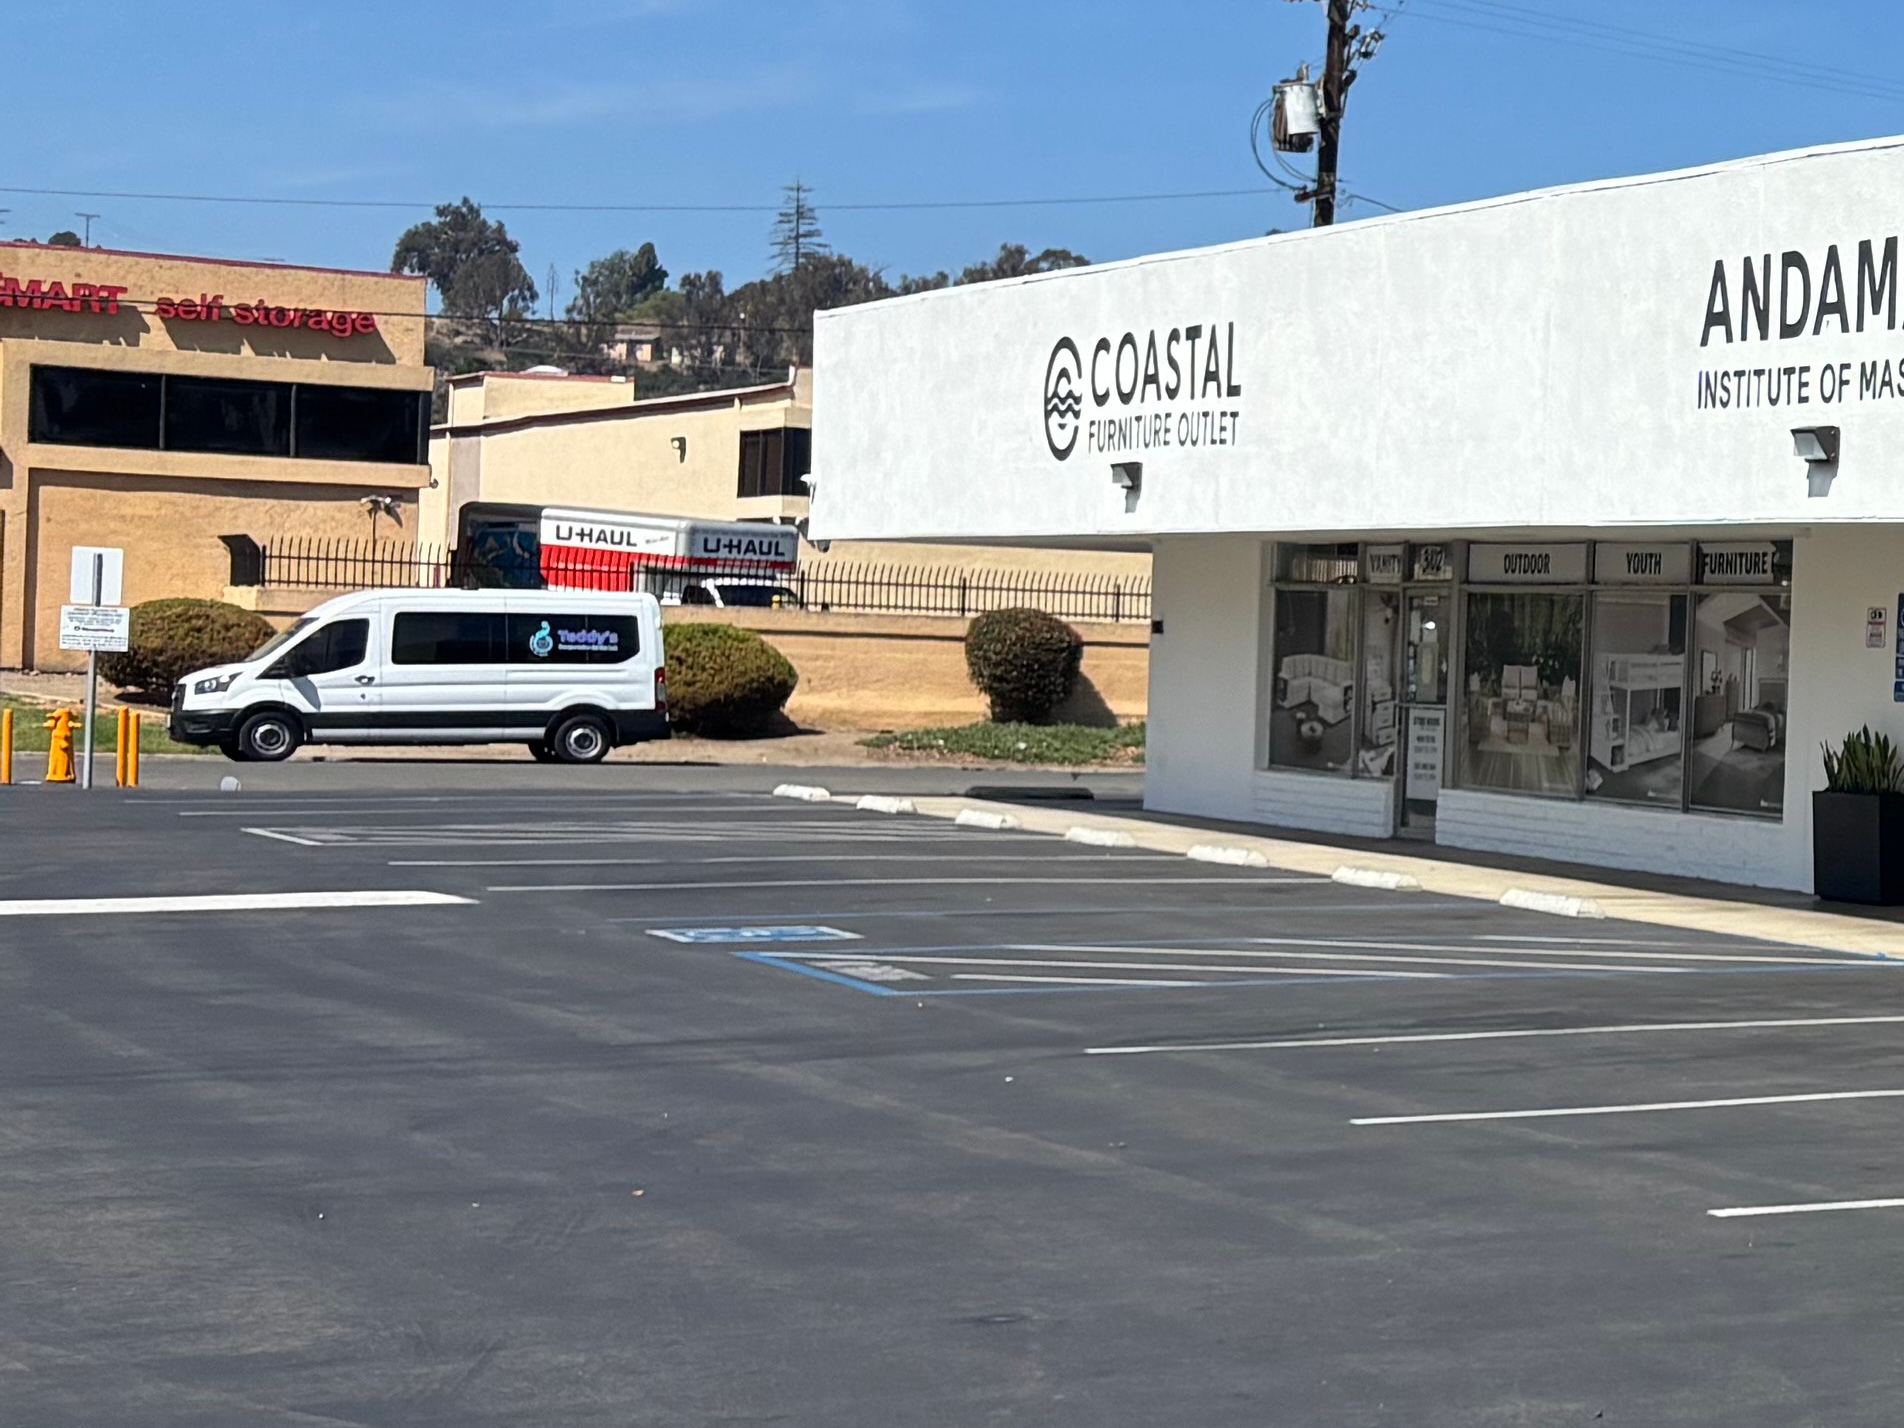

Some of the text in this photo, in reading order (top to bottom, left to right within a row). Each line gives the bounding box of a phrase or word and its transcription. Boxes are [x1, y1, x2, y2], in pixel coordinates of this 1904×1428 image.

[0, 272, 376, 337] MART self storage
[1091, 321, 1241, 407] COASTAL
[1697, 366, 1810, 409] INSTITUTE
[1820, 363, 1851, 404] OF
[1088, 411, 1239, 454] FURNITURE OUTLET
[556, 525, 637, 547] U-HAUL
[703, 536, 785, 557] U-HAUL
[1503, 553, 1550, 574] OUTDOOR
[1626, 552, 1661, 574] YOUTH
[1703, 552, 1768, 574] FURNITURE
[557, 629, 618, 645] Teddy's
